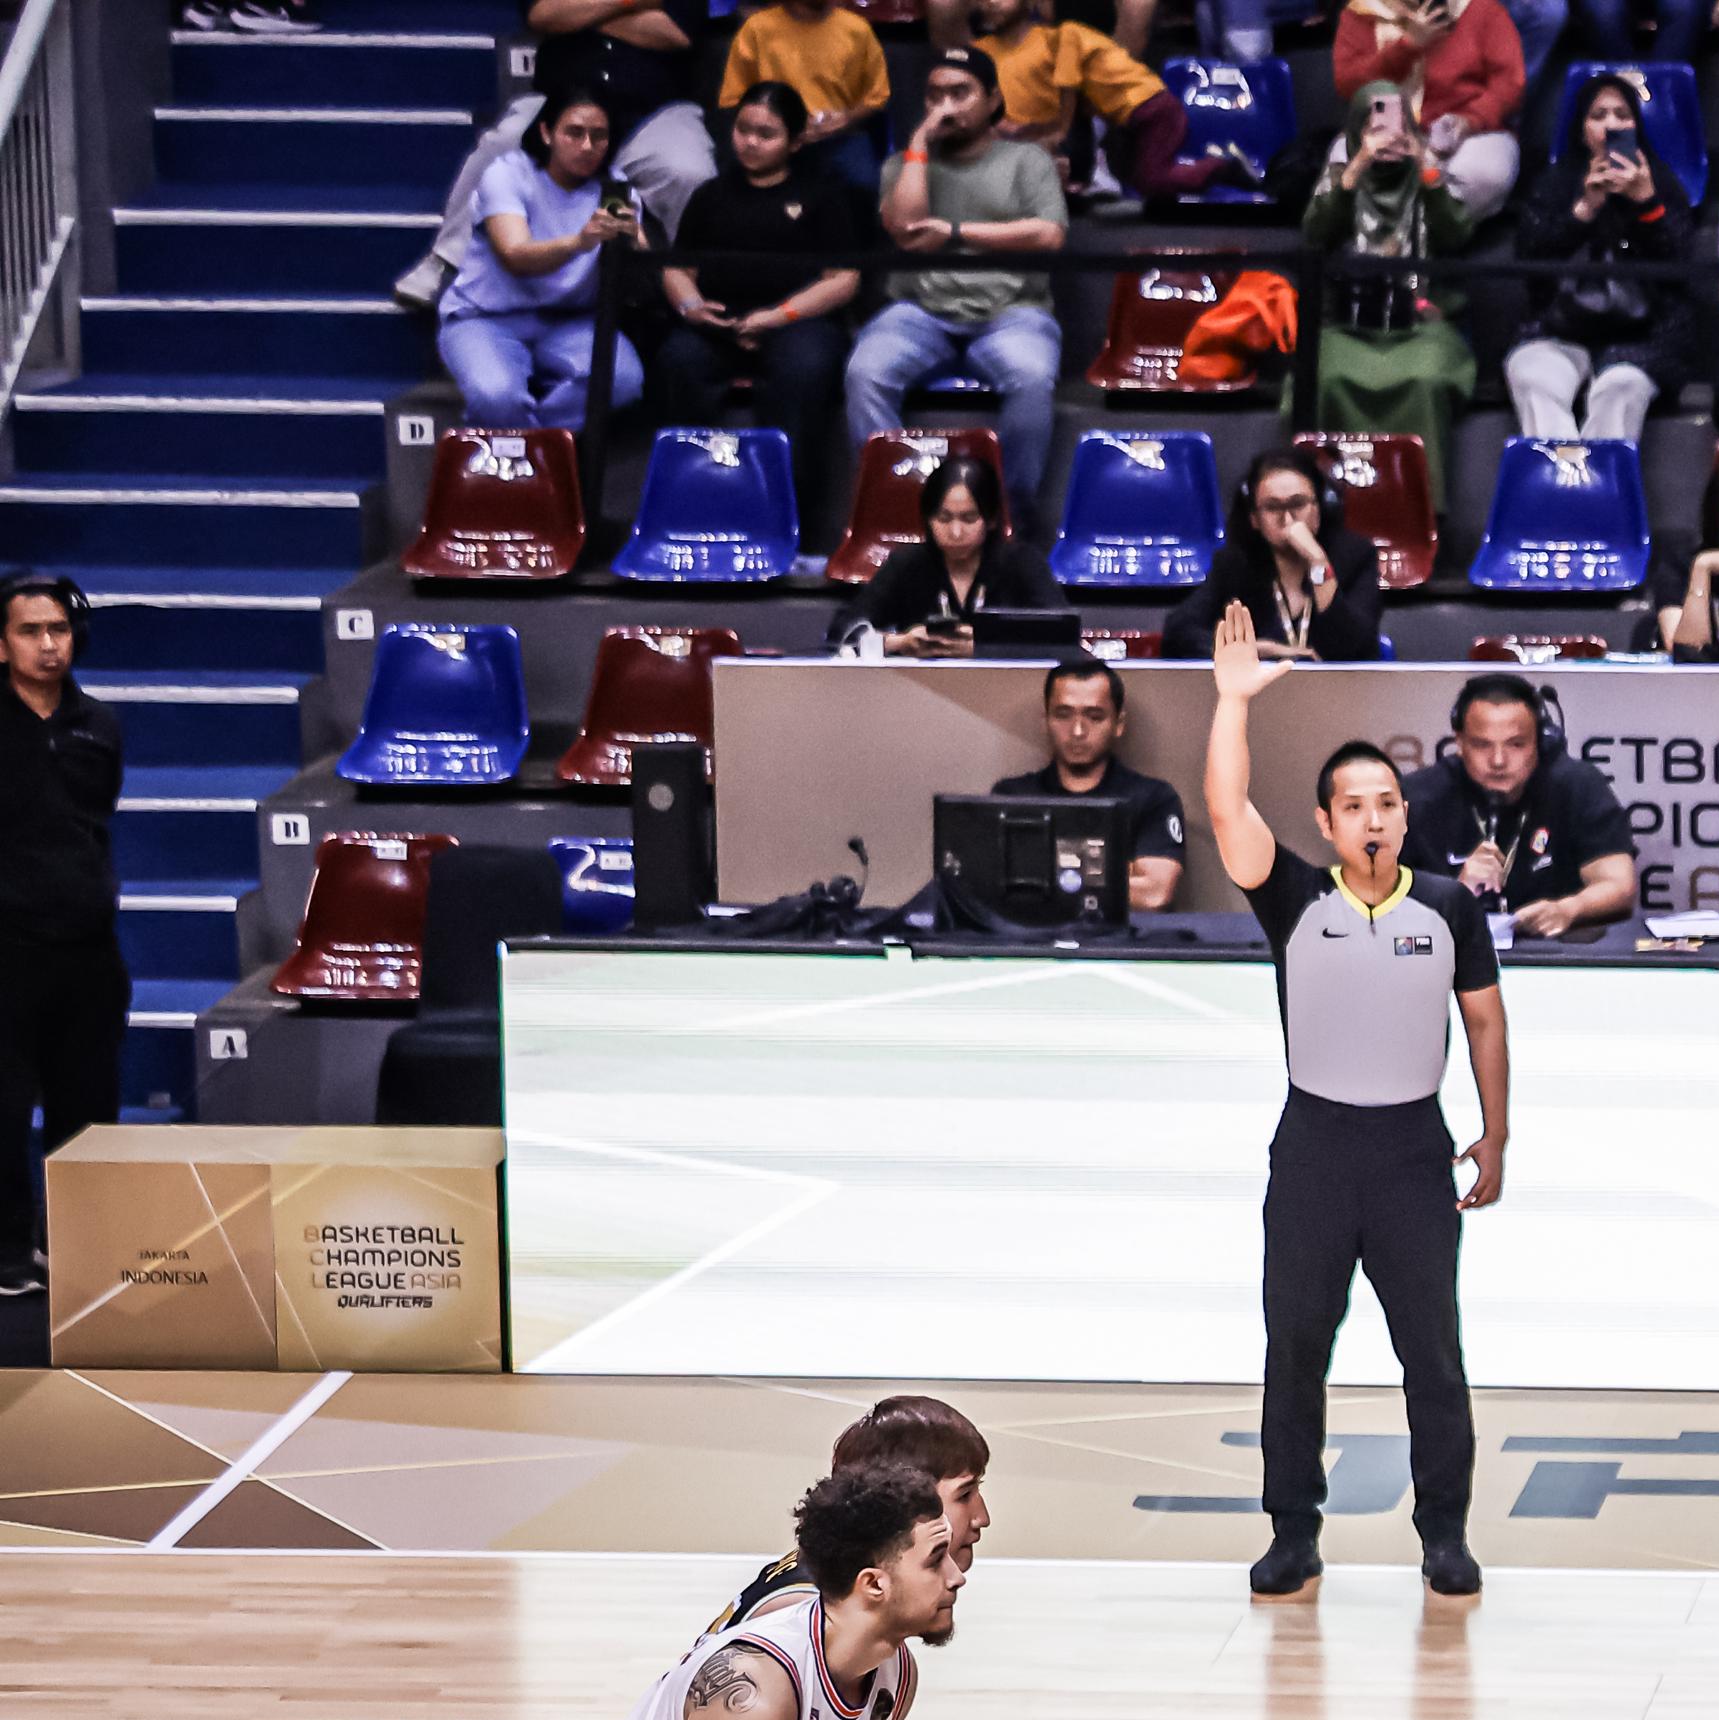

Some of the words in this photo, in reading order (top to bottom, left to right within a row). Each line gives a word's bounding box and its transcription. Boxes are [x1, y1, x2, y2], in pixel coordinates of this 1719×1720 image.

[409, 422, 425, 440] D
[349, 616, 364, 634] C
[222, 1034, 238, 1053] A
[304, 1226, 464, 1244] BASKETBALL
[139, 1249, 190, 1261] JAKARTA
[310, 1250, 462, 1268] CHAMPIONS
[121, 1270, 208, 1285] INDONESIA
[312, 1272, 405, 1290] LEAGUE
[411, 1274, 461, 1290] ASIA
[338, 1295, 433, 1309] QUALIFIERS
